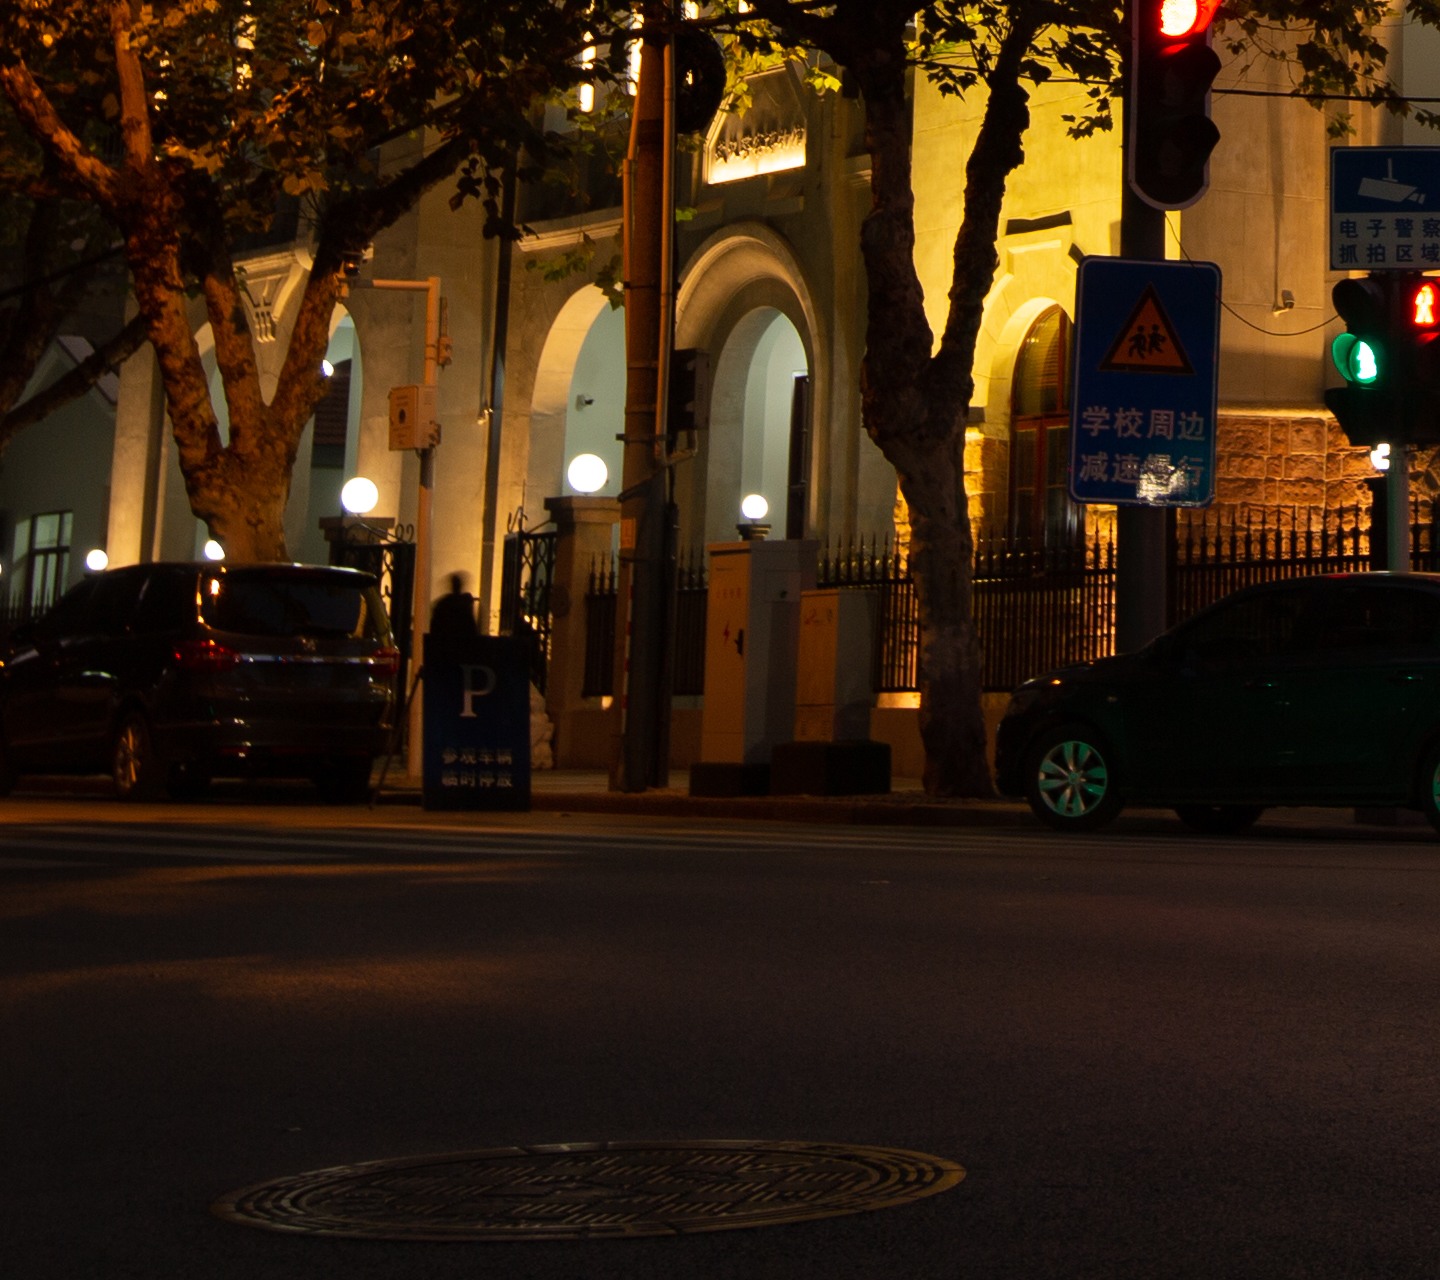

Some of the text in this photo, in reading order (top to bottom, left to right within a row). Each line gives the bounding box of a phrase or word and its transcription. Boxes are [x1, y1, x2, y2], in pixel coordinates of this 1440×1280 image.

[1339, 243, 1440, 264] 抓拍区域
[1081, 405, 1206, 441] 学校周边
[459, 663, 497, 718] P
